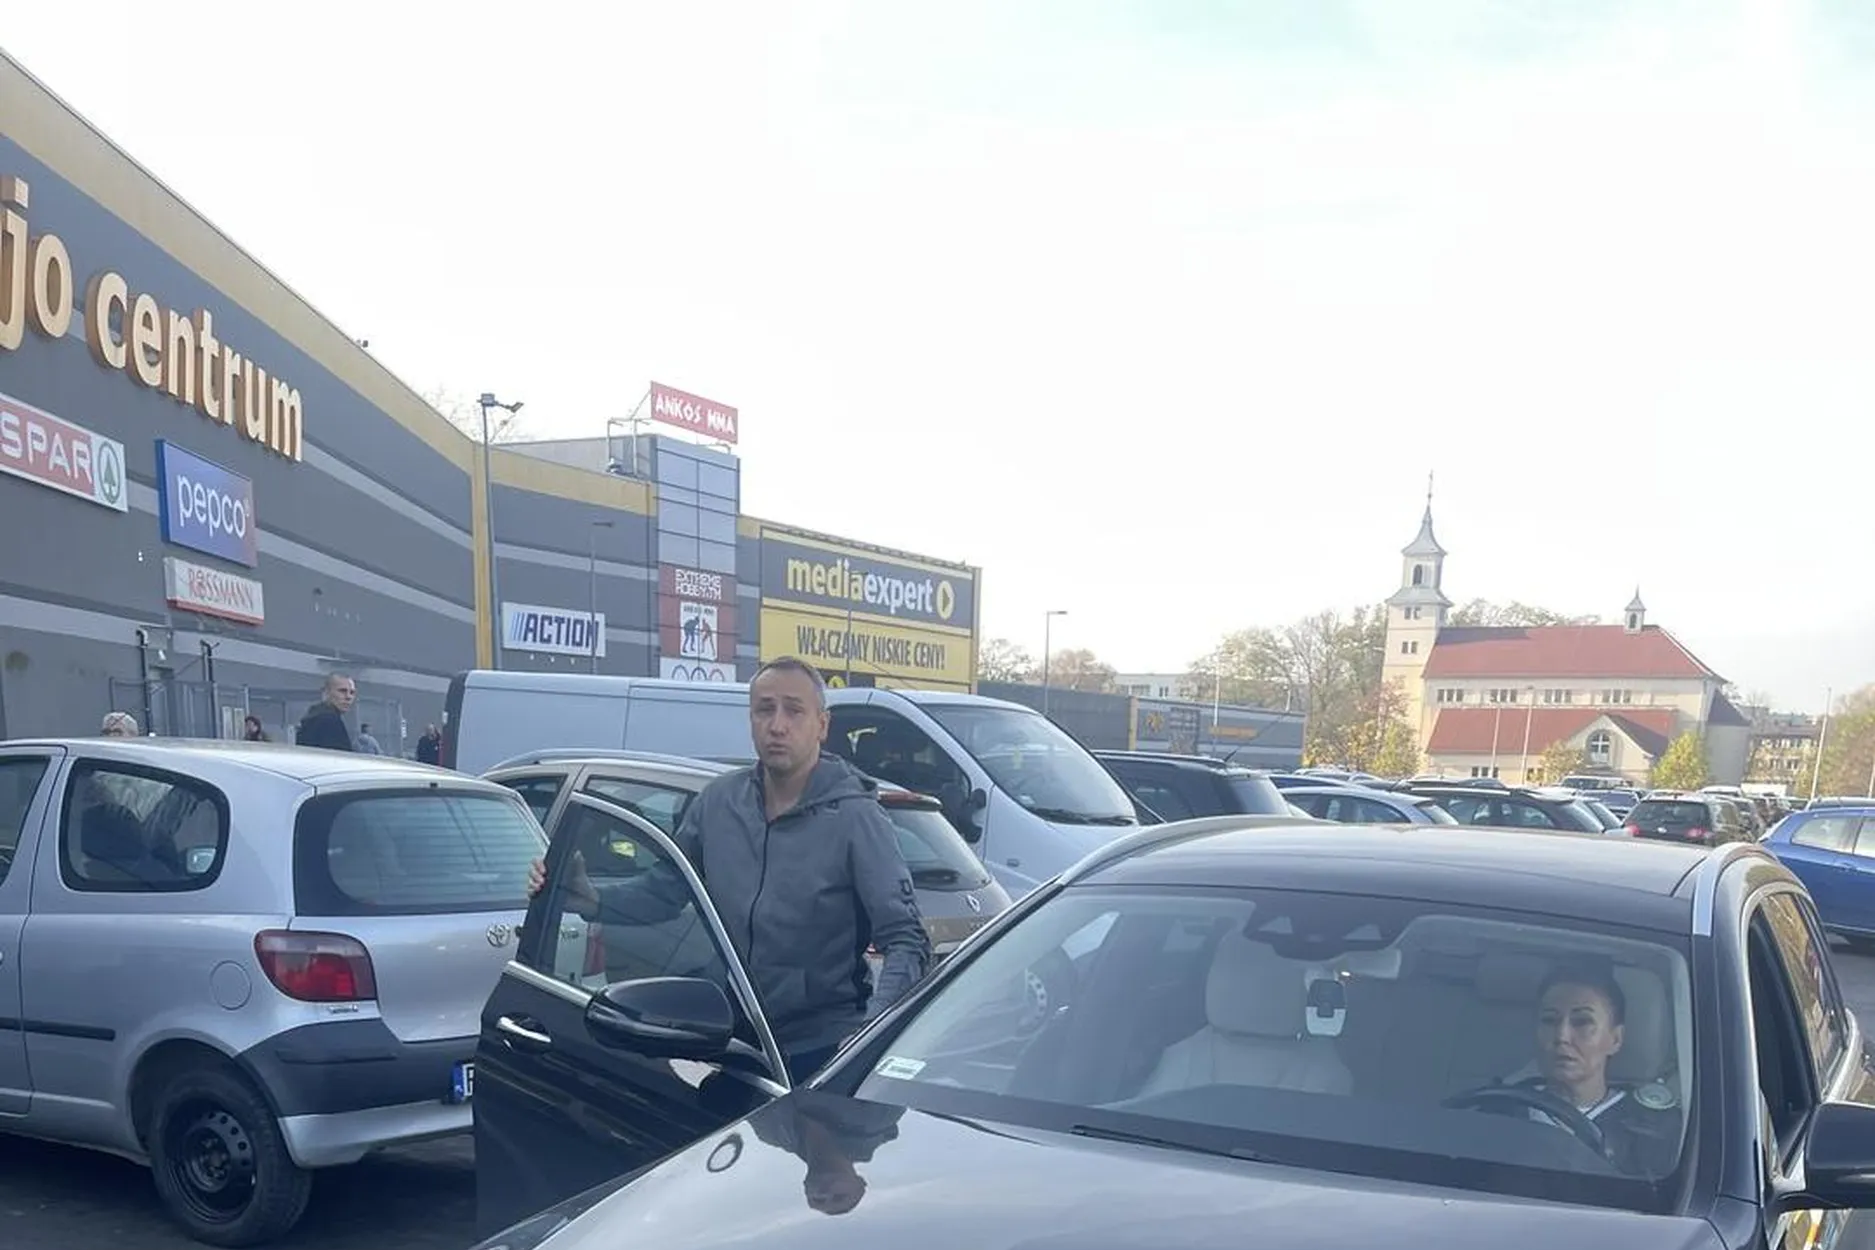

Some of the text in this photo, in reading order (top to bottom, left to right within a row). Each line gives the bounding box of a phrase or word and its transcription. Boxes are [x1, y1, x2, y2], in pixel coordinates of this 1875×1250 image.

[97, 272, 302, 462] centrum
[1, 411, 93, 485] SPAR
[177, 474, 246, 539] pepco
[188, 567, 254, 610] ROSSMANN
[787, 557, 933, 614] mediaexpert
[523, 613, 599, 649] ACTION
[872, 635, 911, 667] NISKIE
[913, 642, 945, 671] CENY!
